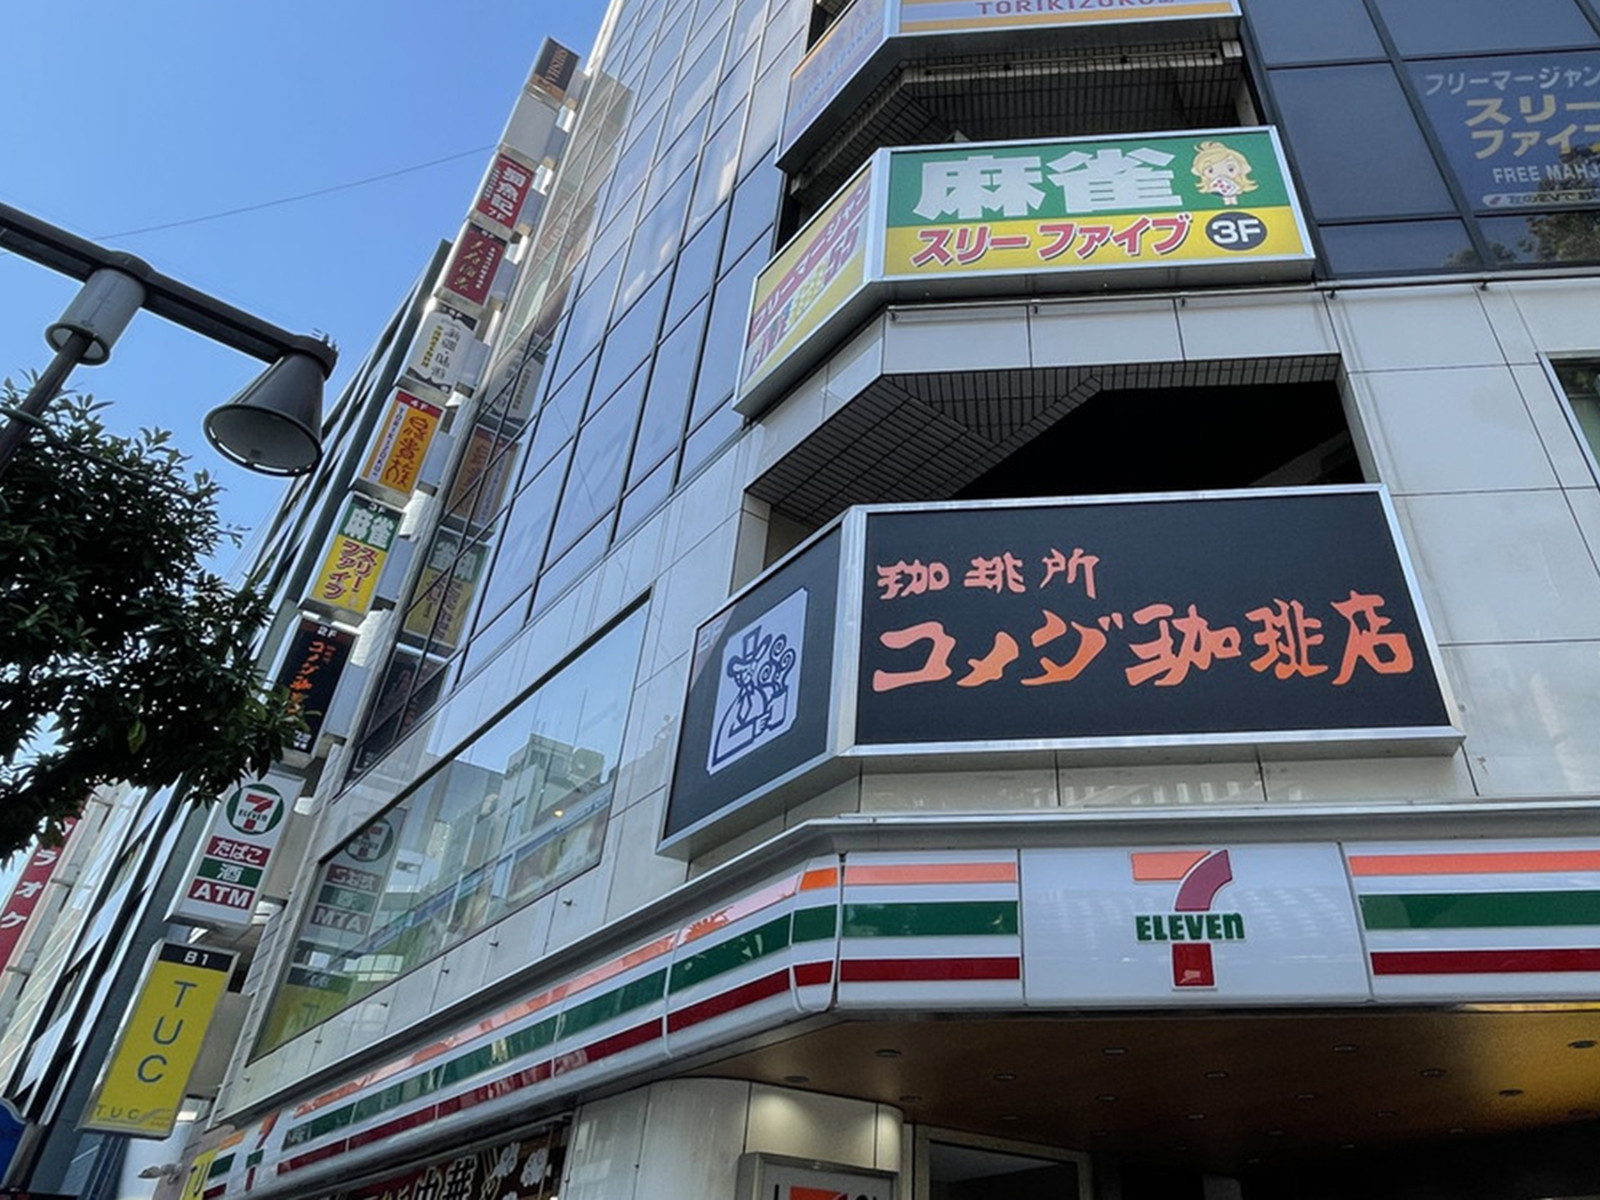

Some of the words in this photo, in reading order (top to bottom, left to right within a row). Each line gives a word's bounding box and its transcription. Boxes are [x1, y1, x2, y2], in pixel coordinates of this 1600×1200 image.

[1464, 93, 1600, 127] スリー
[912, 146, 1184, 221] 麻雀
[1492, 165, 1541, 184] FREE
[1546, 163, 1600, 183] MAHJ
[487, 206, 507, 221] 7F
[911, 212, 1193, 268] スリーファイブ
[1210, 219, 1261, 245] 3F
[410, 399, 429, 410] 4F
[368, 501, 387, 513] 3F
[343, 507, 395, 550] 麻雀
[351, 546, 379, 593] スリー
[876, 547, 1100, 599] 珈琲所
[316, 625, 338, 638] 2F
[872, 589, 1414, 692] コメダ珈琲店
[213, 840, 263, 864] たばこ
[216, 863, 245, 883] 酒
[193, 882, 251, 908] ATM
[1130, 849, 1233, 987] 7
[184, 951, 209, 966] B1
[137, 980, 198, 1083] TUC
